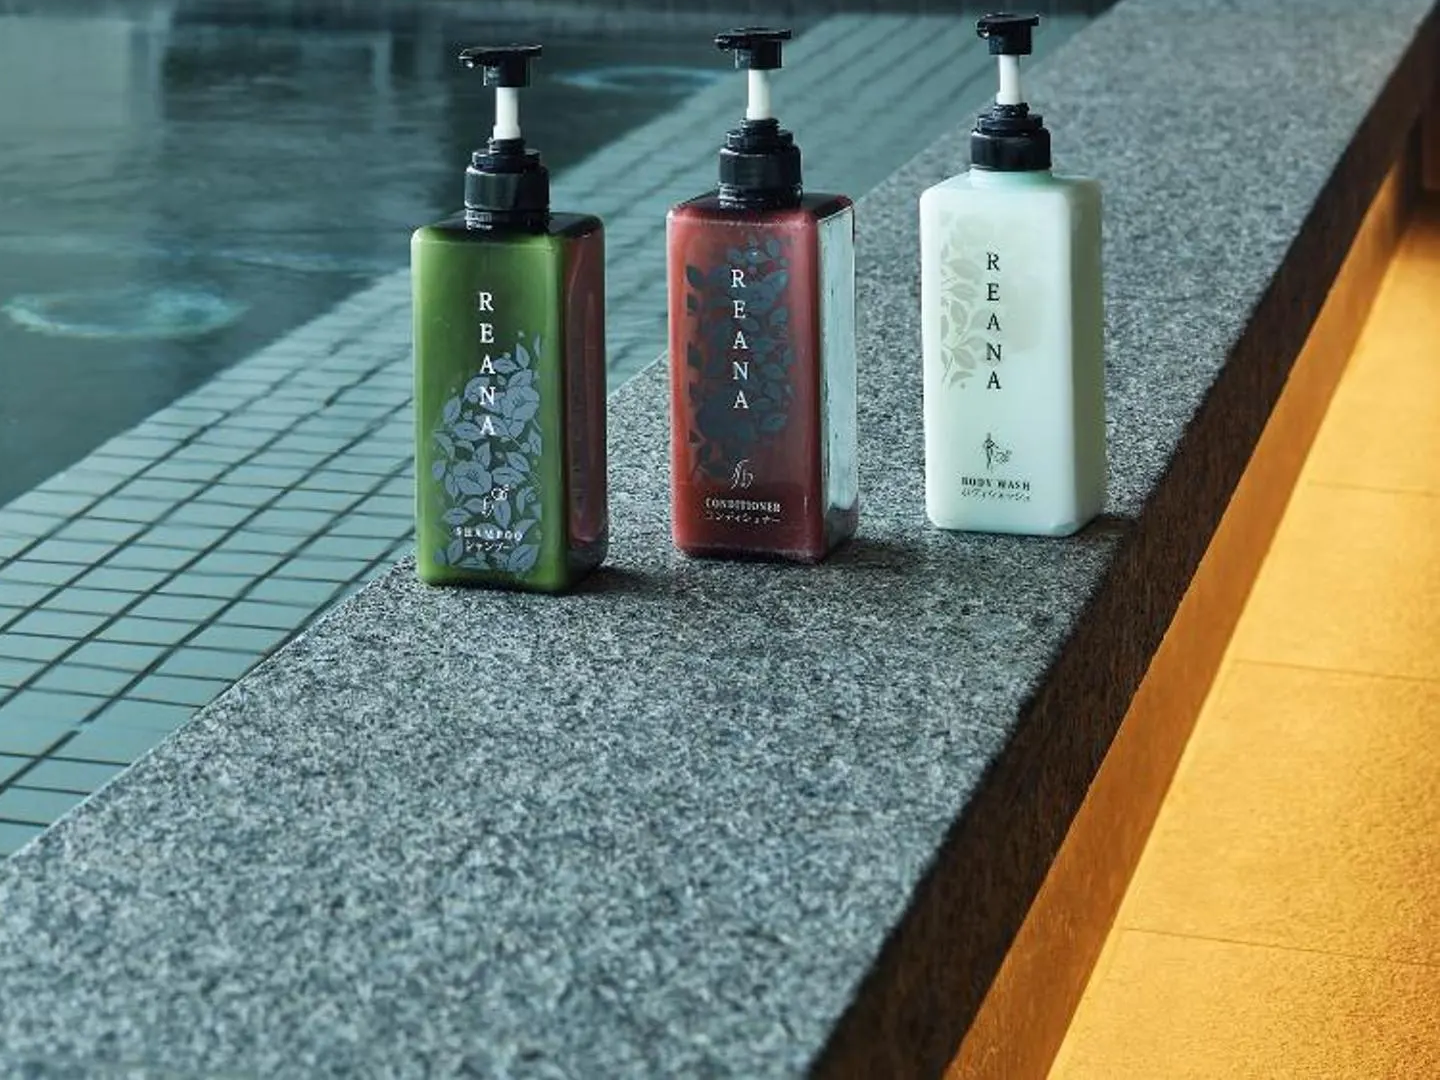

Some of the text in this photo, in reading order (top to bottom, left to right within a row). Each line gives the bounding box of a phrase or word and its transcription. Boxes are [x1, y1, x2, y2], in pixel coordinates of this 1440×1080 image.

[730, 269, 750, 410] REANA
[985, 251, 1003, 391] REANA
[478, 291, 496, 437] REANA
[705, 497, 780, 513] CONDITIONER
[961, 476, 1030, 491] BODY WASH
[455, 525, 524, 541] SHAMPOO
